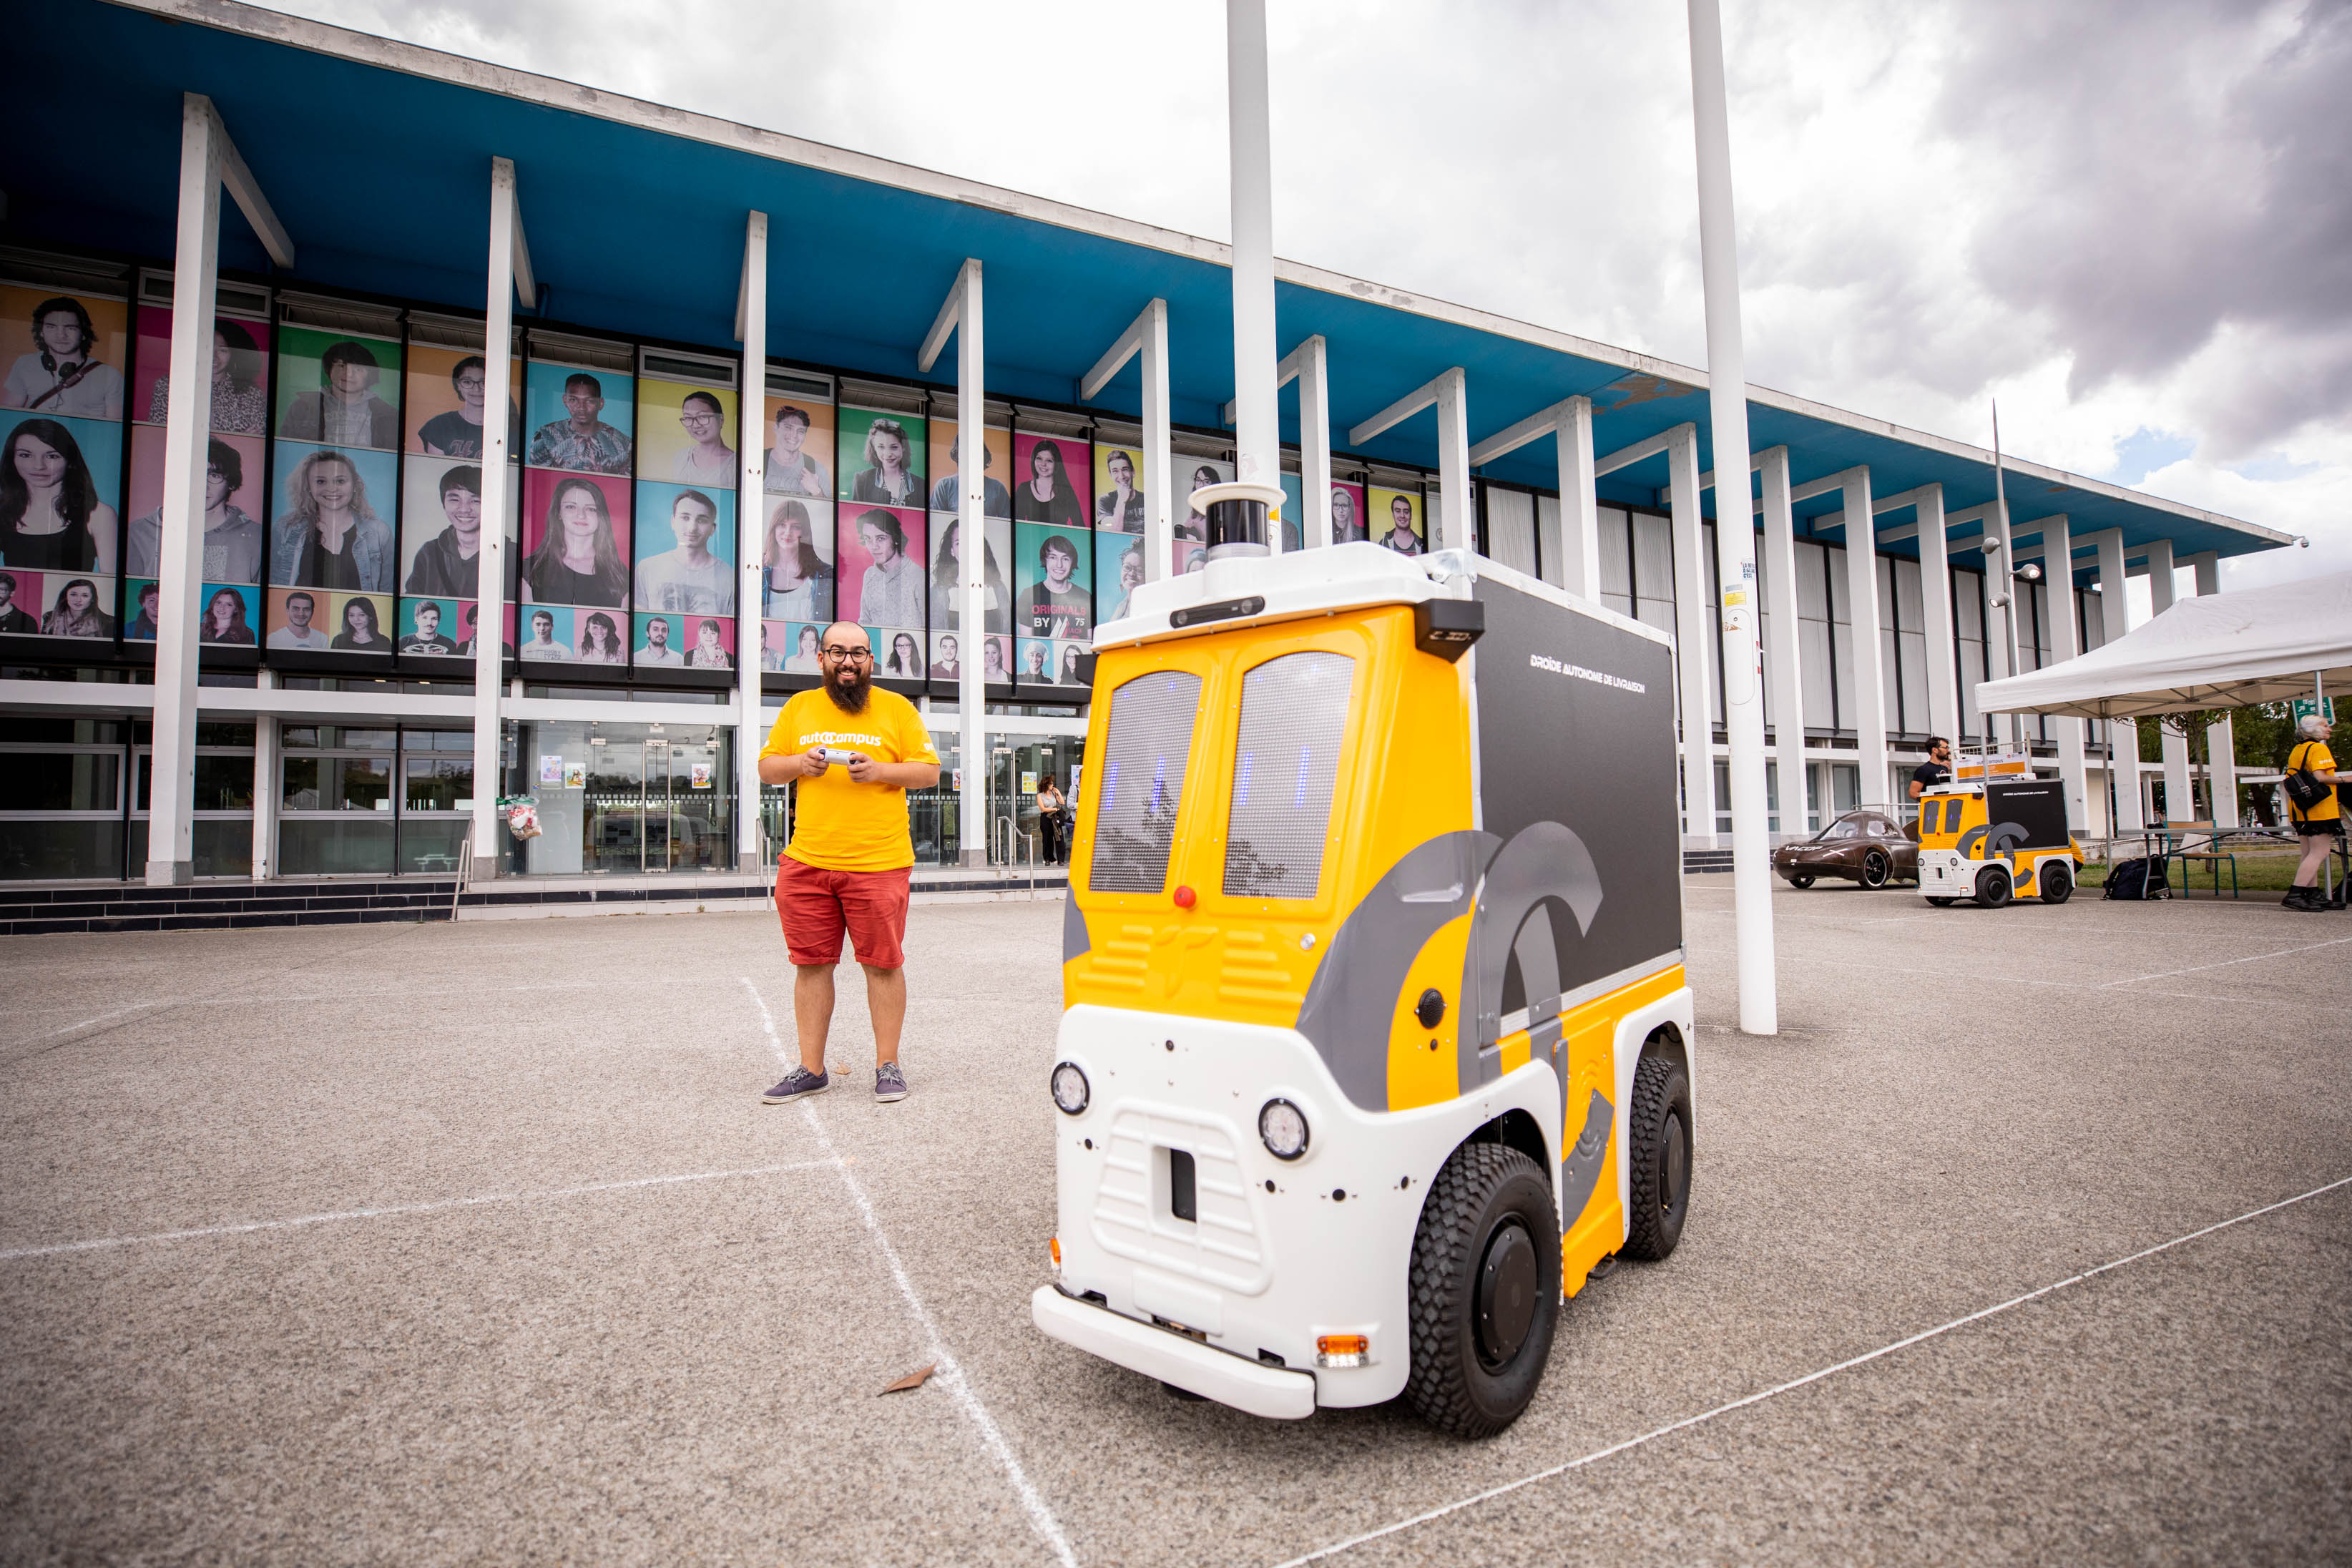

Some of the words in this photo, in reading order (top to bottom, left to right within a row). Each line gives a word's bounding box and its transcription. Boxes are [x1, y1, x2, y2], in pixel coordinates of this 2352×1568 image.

[1032, 604, 1086, 615] ORIGINALS
[1034, 617, 1050, 628] BY
[1075, 617, 1085, 627] 75
[1562, 663, 1603, 684] AUTONOME
[1603, 675, 1613, 686] DE
[1613, 677, 1645, 694] LIVRAISON
